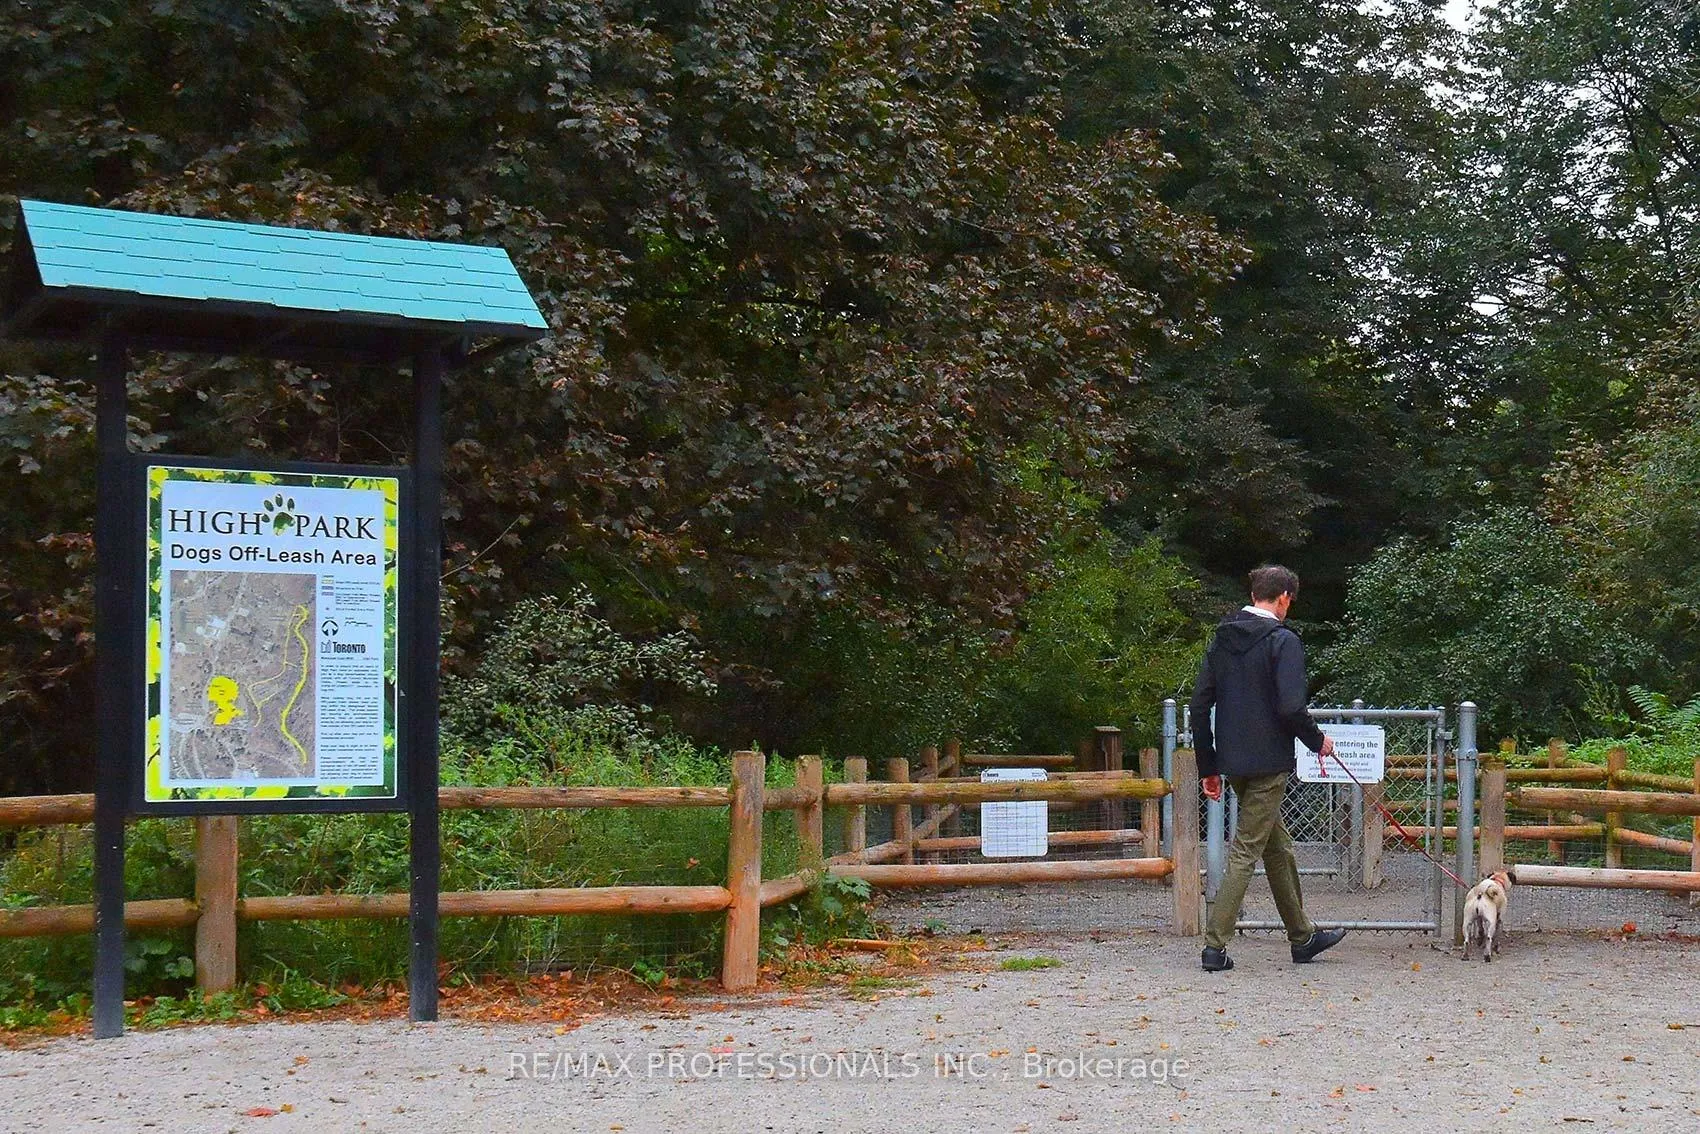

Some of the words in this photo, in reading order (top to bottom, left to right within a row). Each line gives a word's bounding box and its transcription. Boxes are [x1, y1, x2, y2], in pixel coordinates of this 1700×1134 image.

[168, 509, 263, 535] HIGH
[294, 514, 377, 540] PARK
[171, 544, 221, 562] Dogs
[229, 546, 324, 564] Off-Leash
[331, 550, 377, 565] Area
[1335, 741, 1365, 749] entering
[1336, 751, 1358, 759] -leash
